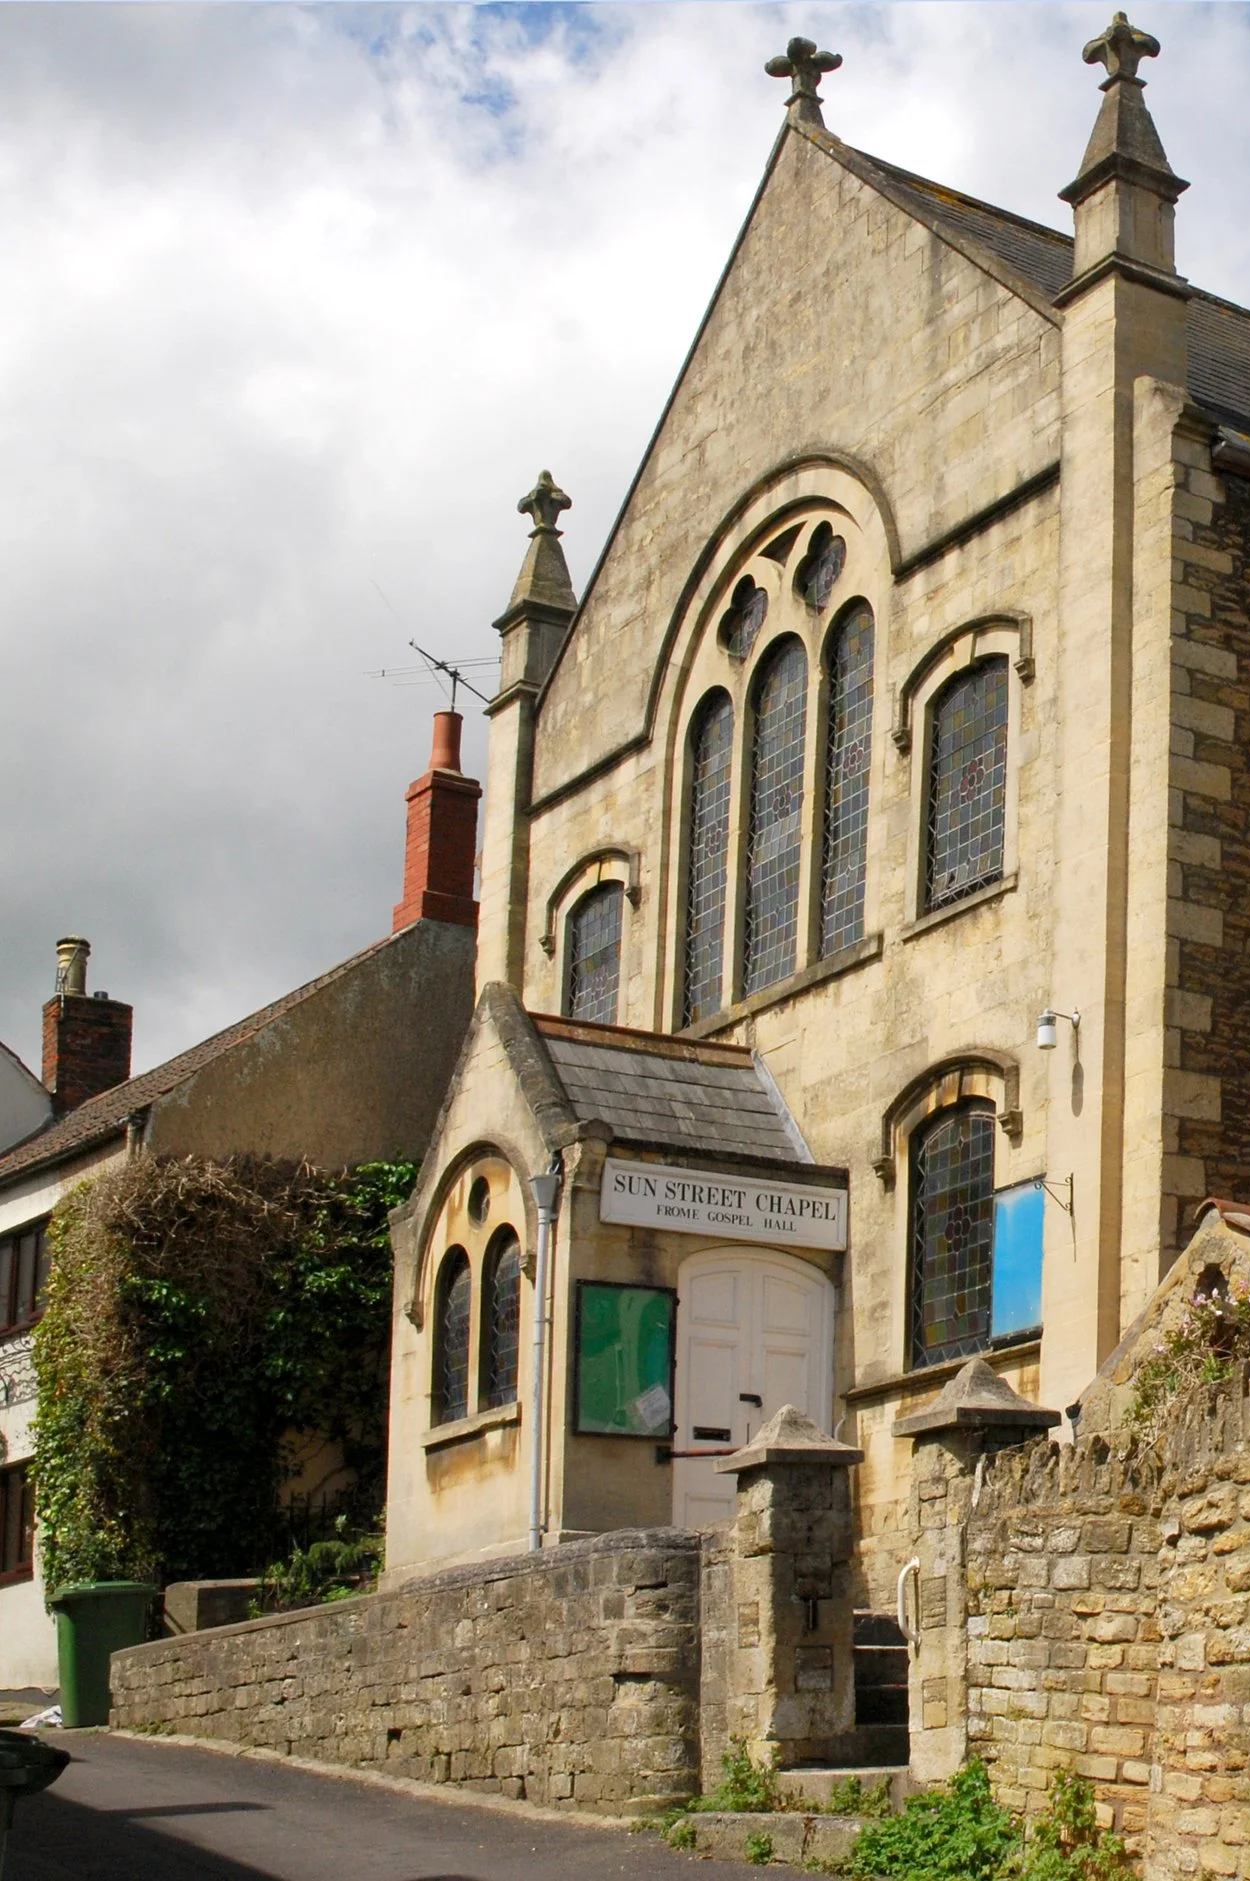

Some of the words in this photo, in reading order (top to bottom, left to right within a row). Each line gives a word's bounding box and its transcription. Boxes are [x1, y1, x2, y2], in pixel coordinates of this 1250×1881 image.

[613, 1174, 658, 1197] SUN
[664, 1181, 746, 1209] STREET
[756, 1193, 836, 1221] CHAPEL
[656, 1204, 700, 1220] FROME
[707, 1211, 753, 1227] GOSPEL
[764, 1218, 797, 1232] HALL
